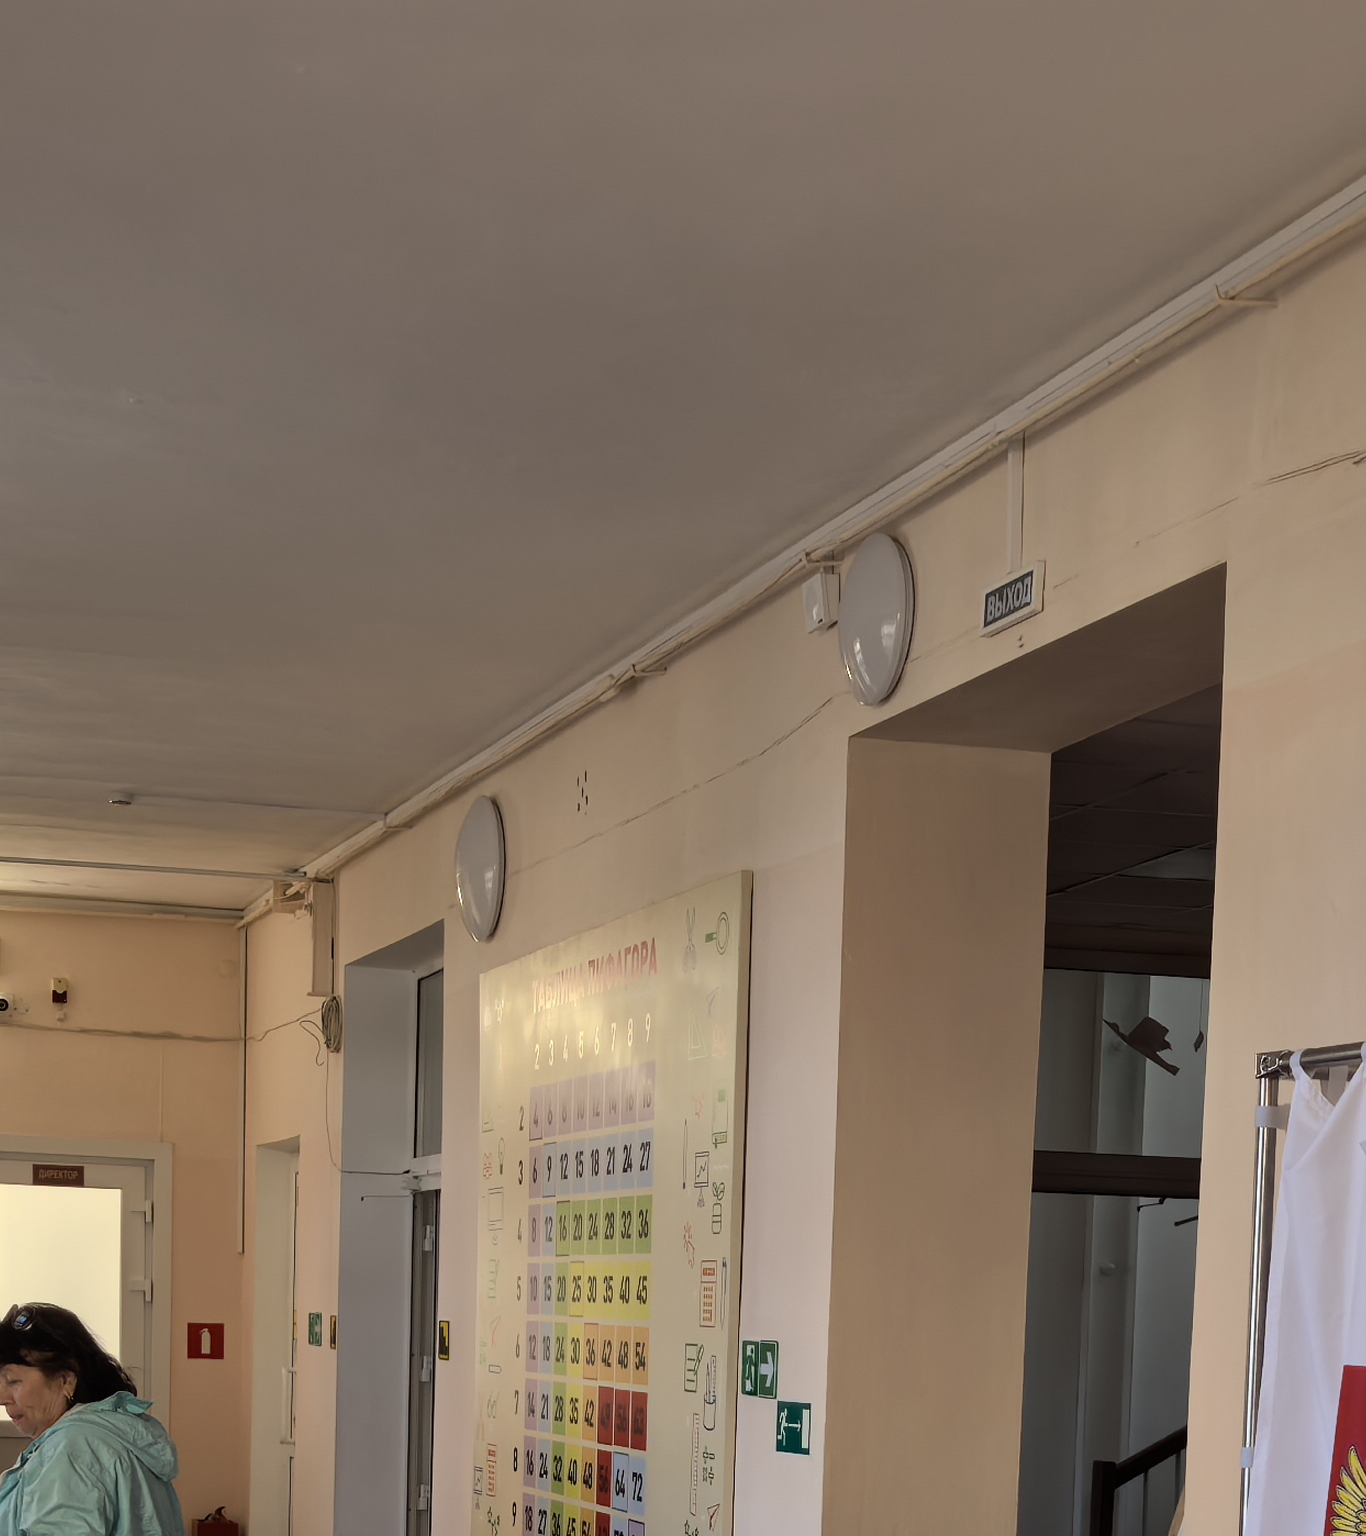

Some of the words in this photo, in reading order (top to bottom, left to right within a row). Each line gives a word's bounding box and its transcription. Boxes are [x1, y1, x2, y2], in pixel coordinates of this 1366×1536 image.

[986, 576, 1031, 622] ВЫХОД
[531, 962, 585, 1014] ТАБЛИЦА
[586, 936, 658, 996] ПИФАГОРА
[534, 1043, 541, 1070] 2
[548, 1039, 555, 1066] 3
[562, 1034, 569, 1062] 4
[578, 1030, 585, 1059] 5
[593, 1026, 601, 1055] 6
[610, 1022, 618, 1052] 7
[627, 1017, 634, 1048] 8
[645, 1012, 652, 1043] 9
[519, 1106, 524, 1131] 2
[533, 1103, 538, 1128] 4
[38, 1169, 78, 1179] ДИРЕКТОР
[519, 1160, 523, 1185] 3
[533, 1158, 537, 1183] 6
[547, 1156, 551, 1182] 9
[560, 1153, 568, 1180] 12
[575, 1151, 583, 1178] 15
[591, 1149, 599, 1176] 18
[607, 1147, 615, 1175] 21
[623, 1144, 633, 1173] 24
[640, 1141, 651, 1171] 27
[518, 1218, 521, 1243] 4
[532, 1218, 536, 1242] 8
[545, 1216, 553, 1242] 12
[559, 1215, 567, 1242] 16
[573, 1214, 582, 1241] 20
[589, 1213, 598, 1240] 24
[605, 1212, 614, 1240] 28
[621, 1211, 631, 1239] 32
[639, 1209, 648, 1238] 36
[517, 1276, 521, 1301] 5
[530, 1276, 537, 1301] 10
[544, 1276, 551, 1301] 15
[557, 1276, 566, 1302] 20
[572, 1276, 581, 1302] 25
[587, 1276, 597, 1302] 30
[603, 1276, 613, 1303] 35
[620, 1276, 630, 1304] 40
[637, 1276, 647, 1304] 45
[516, 1334, 520, 1358] 6
[529, 1335, 536, 1360] 12
[543, 1336, 550, 1361] 18
[556, 1336, 564, 1362] 24
[571, 1337, 580, 1364] 30
[586, 1338, 595, 1366] 36
[602, 1340, 612, 1367] 42
[618, 1341, 629, 1369] 48
[635, 1342, 645, 1371] 54
[515, 1390, 518, 1414] 7
[528, 1392, 535, 1417] 14
[541, 1394, 548, 1420] 21
[555, 1395, 563, 1422] 28
[569, 1397, 579, 1424] 35
[584, 1399, 594, 1428] 42
[514, 1447, 517, 1472] 8
[527, 1450, 534, 1476] 16
[539, 1452, 548, 1479] 24
[553, 1455, 562, 1482] 32
[568, 1458, 577, 1485] 40
[583, 1462, 593, 1489] 48
[615, 1469, 625, 1498] 64
[632, 1472, 643, 1502] 72
[513, 1502, 516, 1526] 9
[525, 1506, 532, 1531] 18
[538, 1509, 547, 1535] 27
